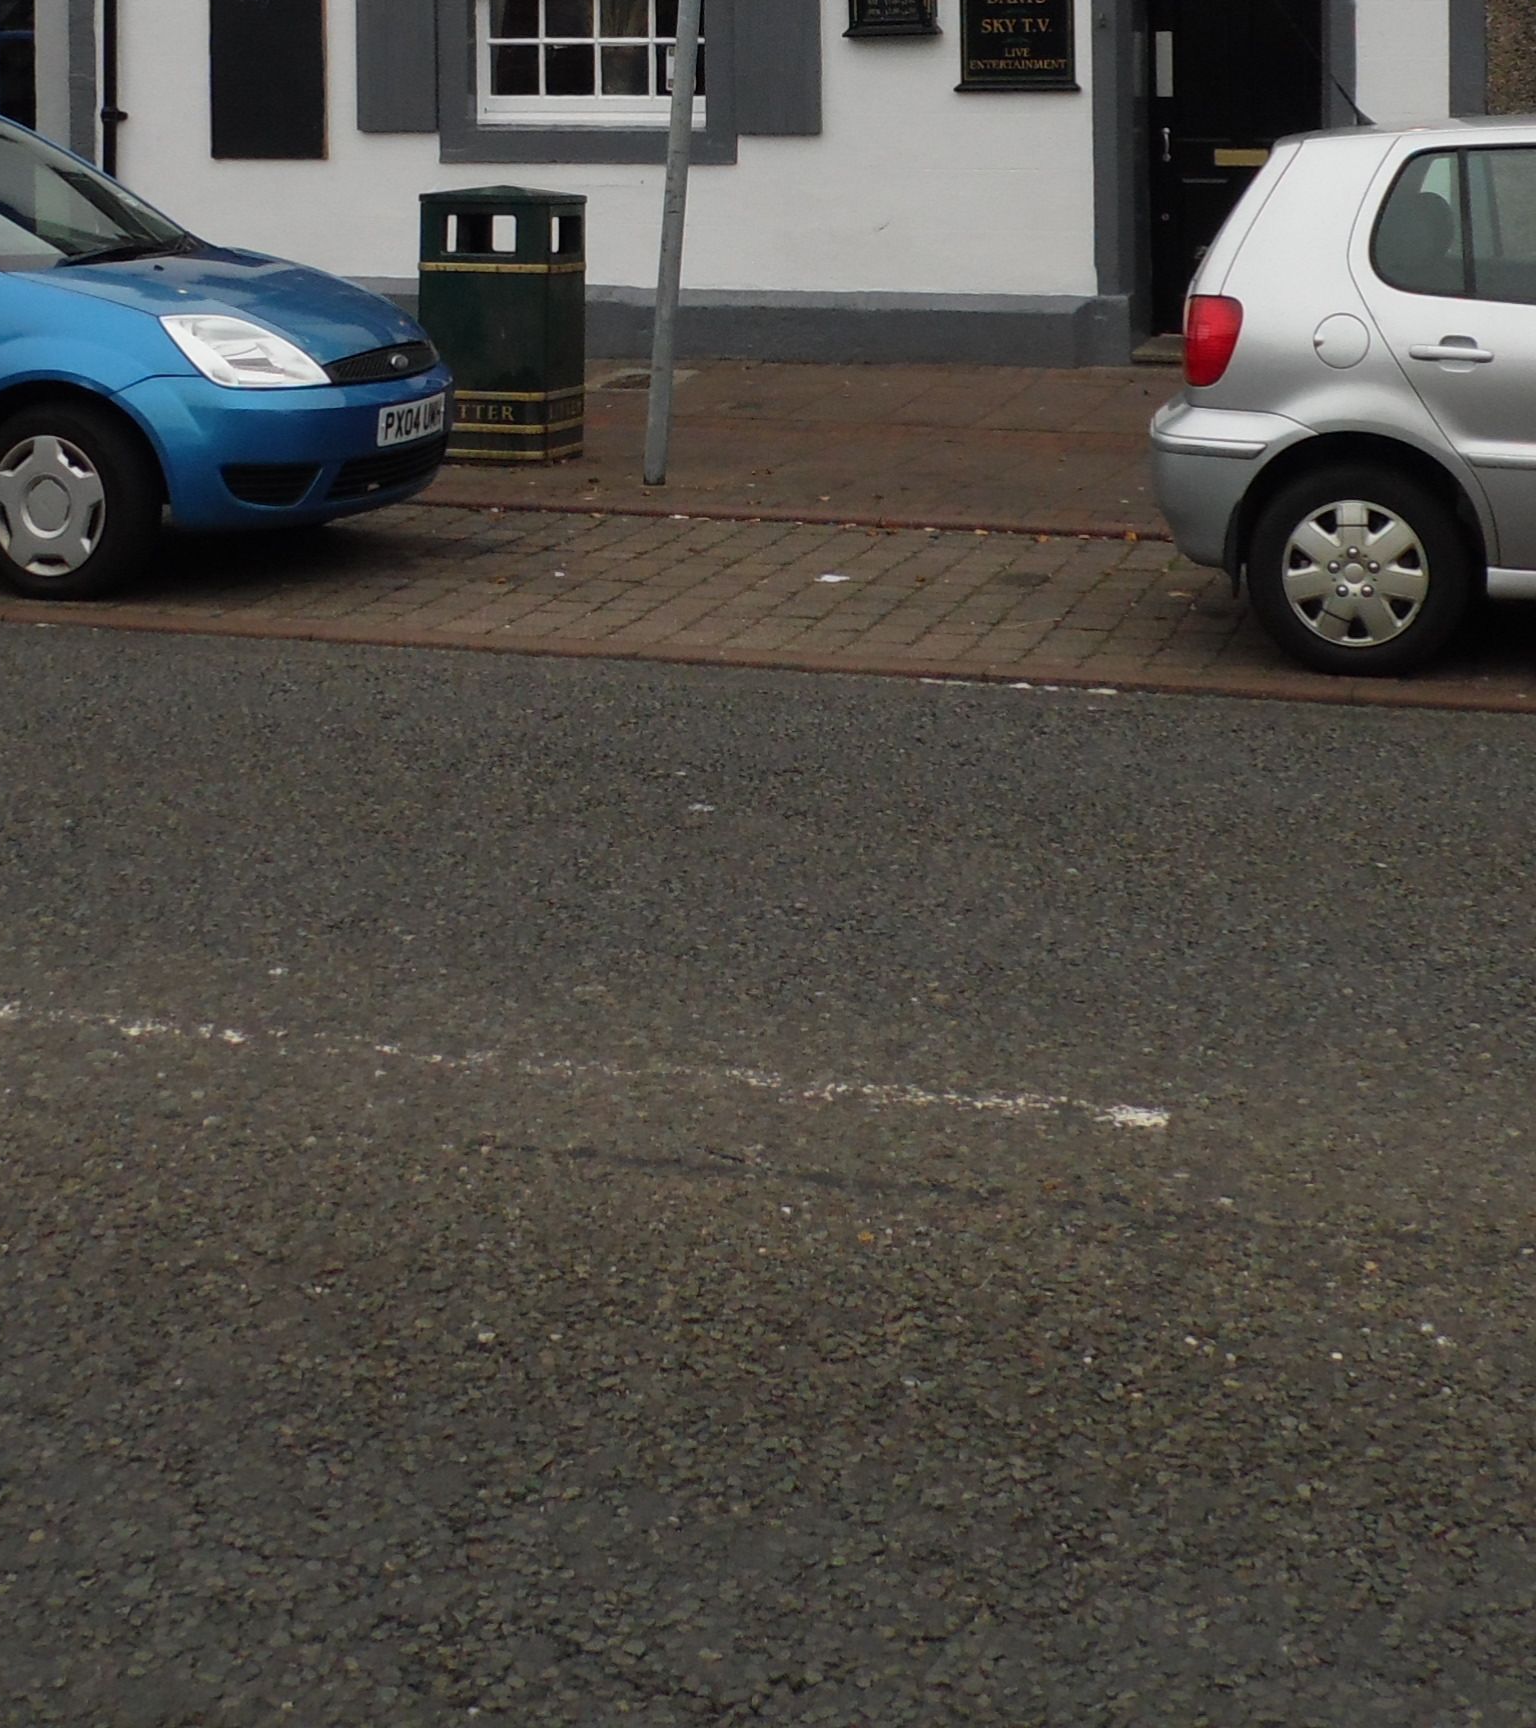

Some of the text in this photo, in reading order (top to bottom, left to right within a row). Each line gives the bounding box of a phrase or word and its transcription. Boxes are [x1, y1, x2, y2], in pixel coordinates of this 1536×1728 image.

[981, 18, 1017, 34] SKY
[1004, 47, 1031, 57] LIVE
[969, 58, 1066, 71] ENTERTAINMENT
[456, 404, 515, 421] TTER
[384, 404, 422, 441] PX04
